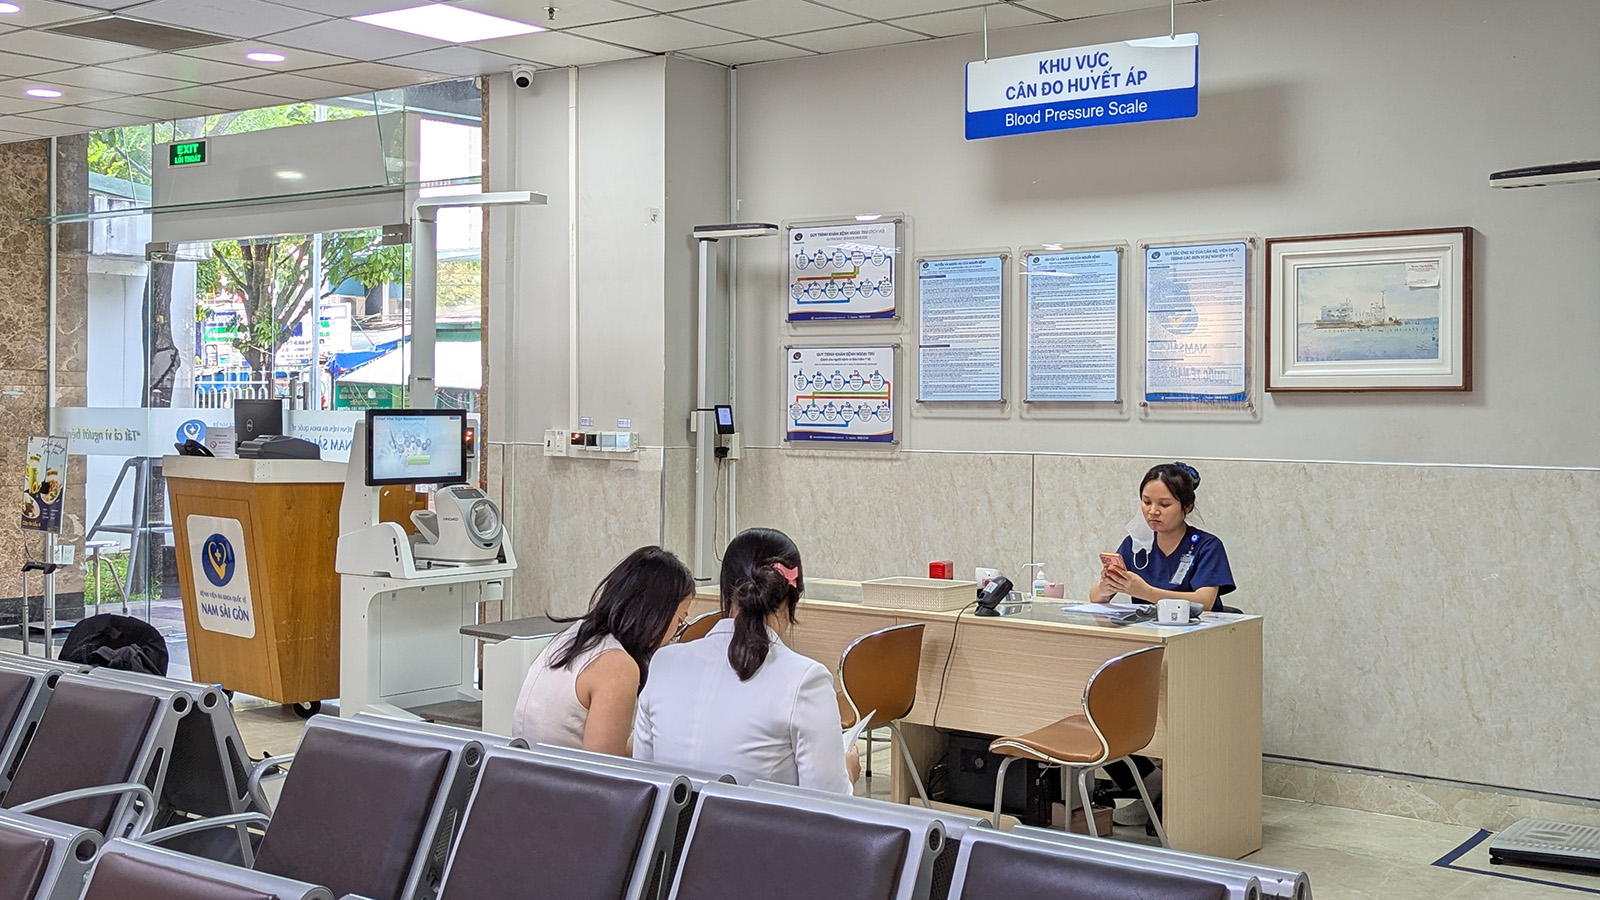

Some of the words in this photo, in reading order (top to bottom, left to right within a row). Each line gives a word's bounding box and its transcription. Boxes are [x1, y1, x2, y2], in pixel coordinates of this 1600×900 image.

[1038, 57, 1072, 75] KHU
[1075, 52, 1110, 73] VỰC
[1005, 82, 1037, 101] CÂN
[1041, 79, 1064, 97] ĐO
[1067, 66, 1121, 94] HUYẾT
[1125, 66, 1148, 88] ÁP
[1005, 109, 1042, 128] Blood
[1044, 104, 1104, 124] Pressure
[1108, 99, 1148, 116] Scale
[174, 154, 184, 164] LỐI
[184, 153, 202, 163] THOÁT
[177, 143, 199, 155] EXIT
[201, 602, 219, 616] NAM
[219, 603, 231, 618] SÀI
[233, 605, 250, 622] GÒN
